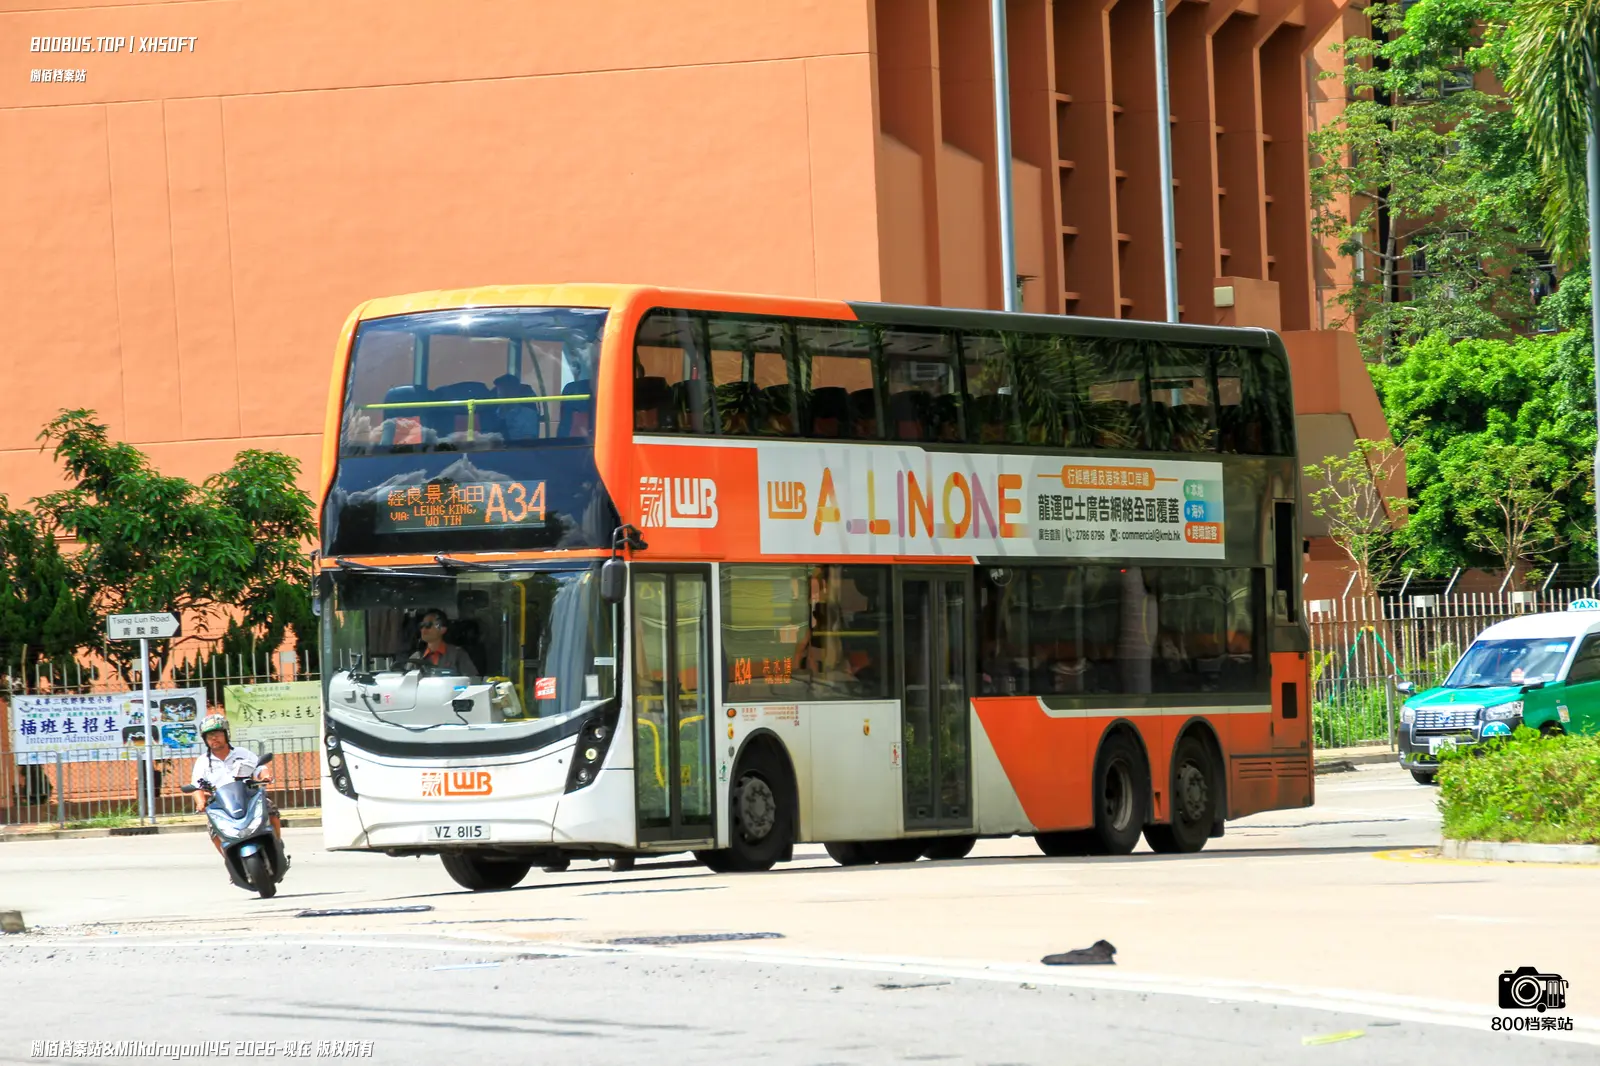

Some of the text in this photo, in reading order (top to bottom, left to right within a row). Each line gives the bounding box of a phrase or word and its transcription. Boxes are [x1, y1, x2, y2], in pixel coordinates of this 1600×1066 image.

[484, 482, 546, 523] A34
[767, 481, 807, 520] LWB
[413, 505, 445, 517] LEUNG
[1038, 493, 1180, 523] 龍運巴士廣告網絡全面覆蓋
[425, 515, 462, 527] WO TIN
[1571, 599, 1599, 609] TAXI
[112, 615, 170, 625] Tsing Lun Road
[735, 657, 752, 685] A34
[20, 716, 120, 736] 插班生招生
[26, 733, 115, 745] Interim Admission
[434, 825, 482, 838] VZ 8115
